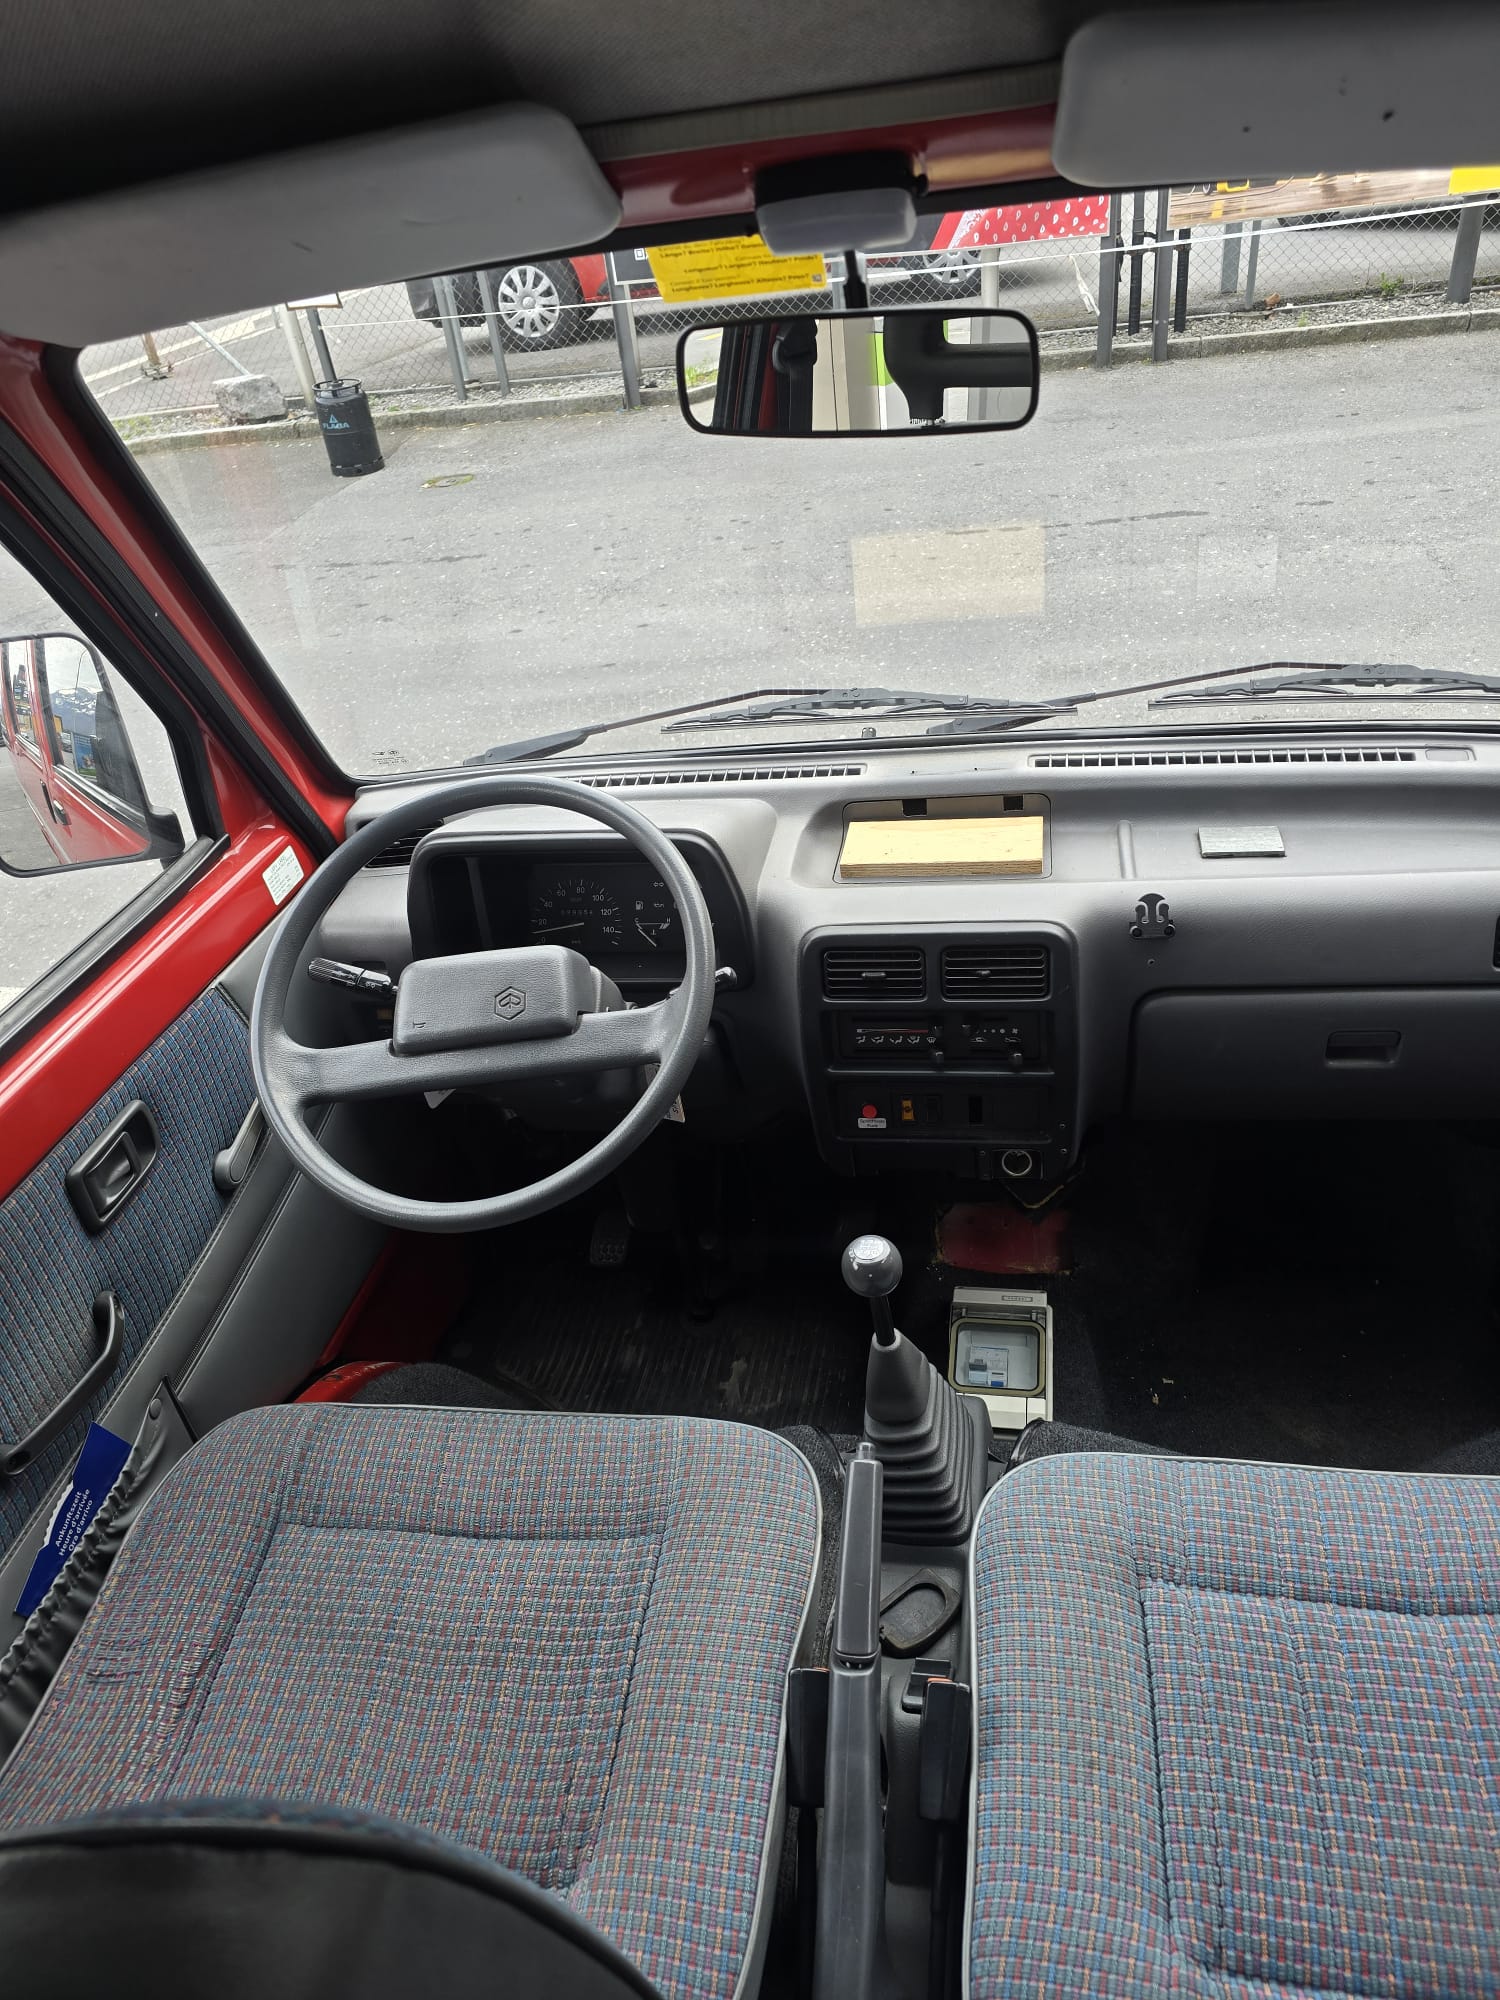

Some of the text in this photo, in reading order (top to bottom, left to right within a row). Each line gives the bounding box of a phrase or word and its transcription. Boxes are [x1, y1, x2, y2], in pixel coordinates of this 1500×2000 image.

[576, 886, 585, 894] 80
[592, 894, 605, 902] 100
[543, 900, 553, 908] 40
[601, 908, 612, 916] 120
[538, 918, 547, 926] 20
[602, 926, 615, 934] 140
[55, 1491, 83, 1547] Ankunftszeit
[59, 1489, 91, 1556] Heure d'arrivée
[68, 1499, 94, 1552] Ora d'arrivo
